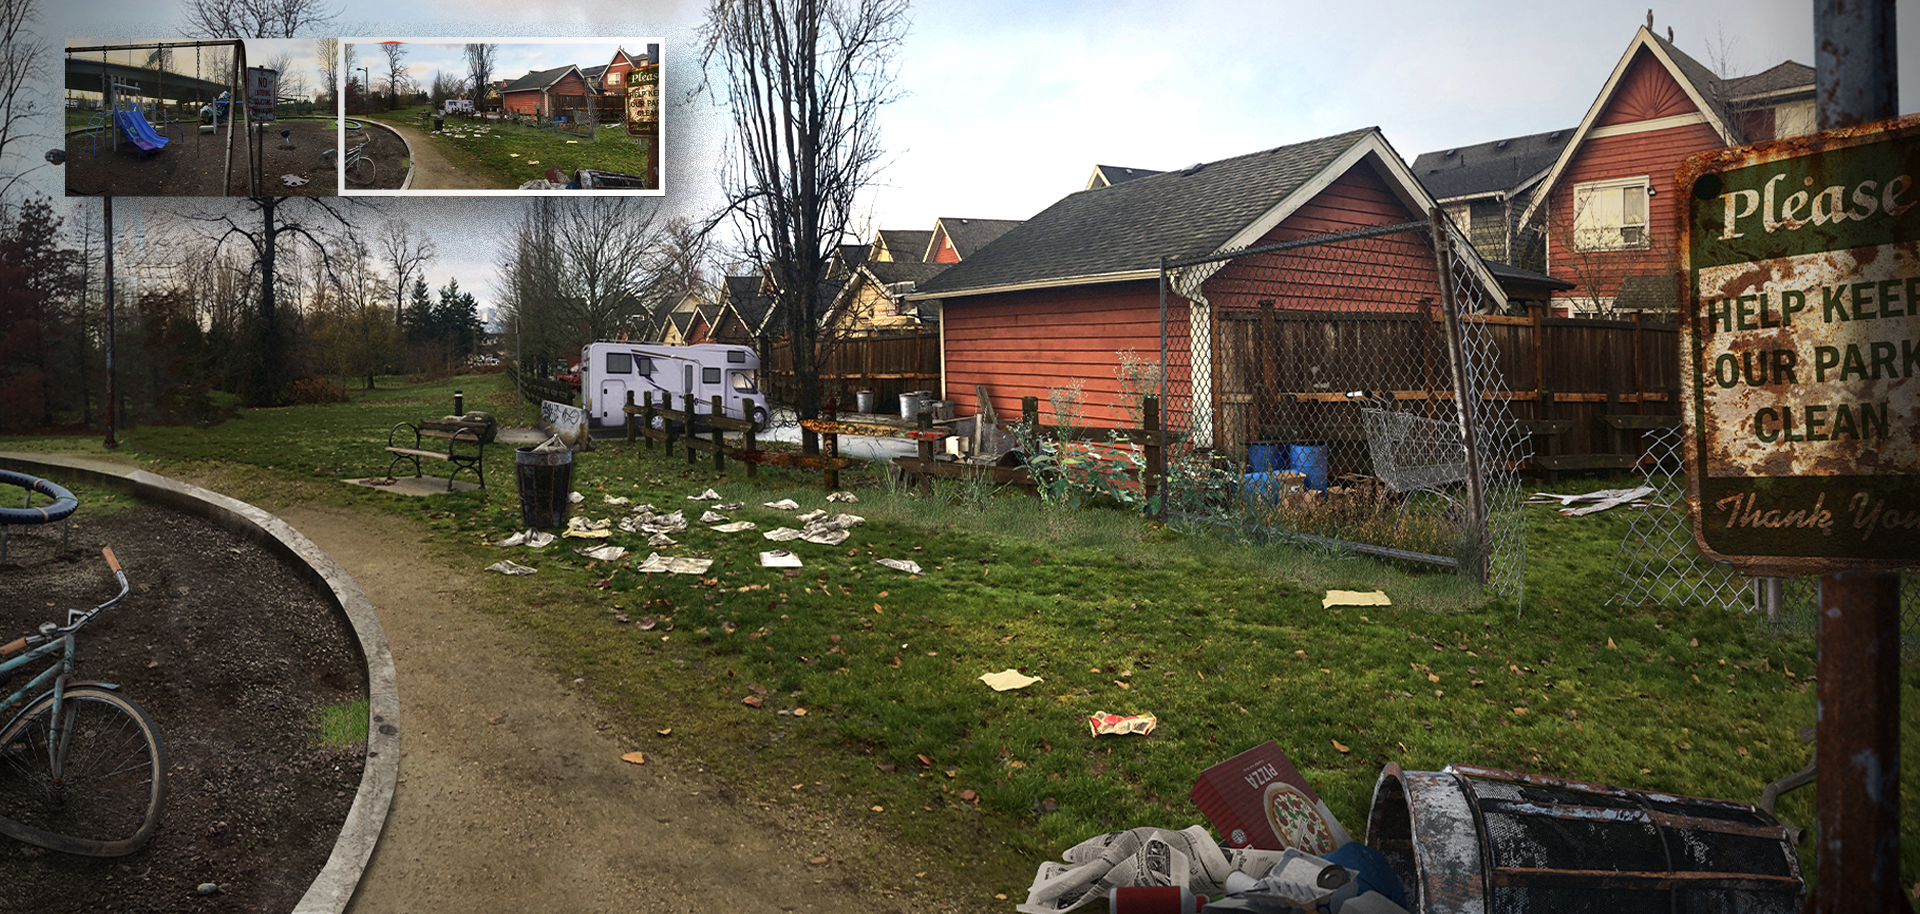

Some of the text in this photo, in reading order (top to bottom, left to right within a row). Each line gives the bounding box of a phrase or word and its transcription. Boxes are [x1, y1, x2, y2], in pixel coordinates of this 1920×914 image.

[258, 77, 267, 88] NO
[1716, 173, 1918, 241] Please
[1708, 289, 1806, 334] HELP
[1715, 339, 1920, 389] OUR PARK
[1755, 402, 1889, 443] CLEAN
[1715, 492, 1834, 532] Thank
[1244, 762, 1279, 790] PIZZA
